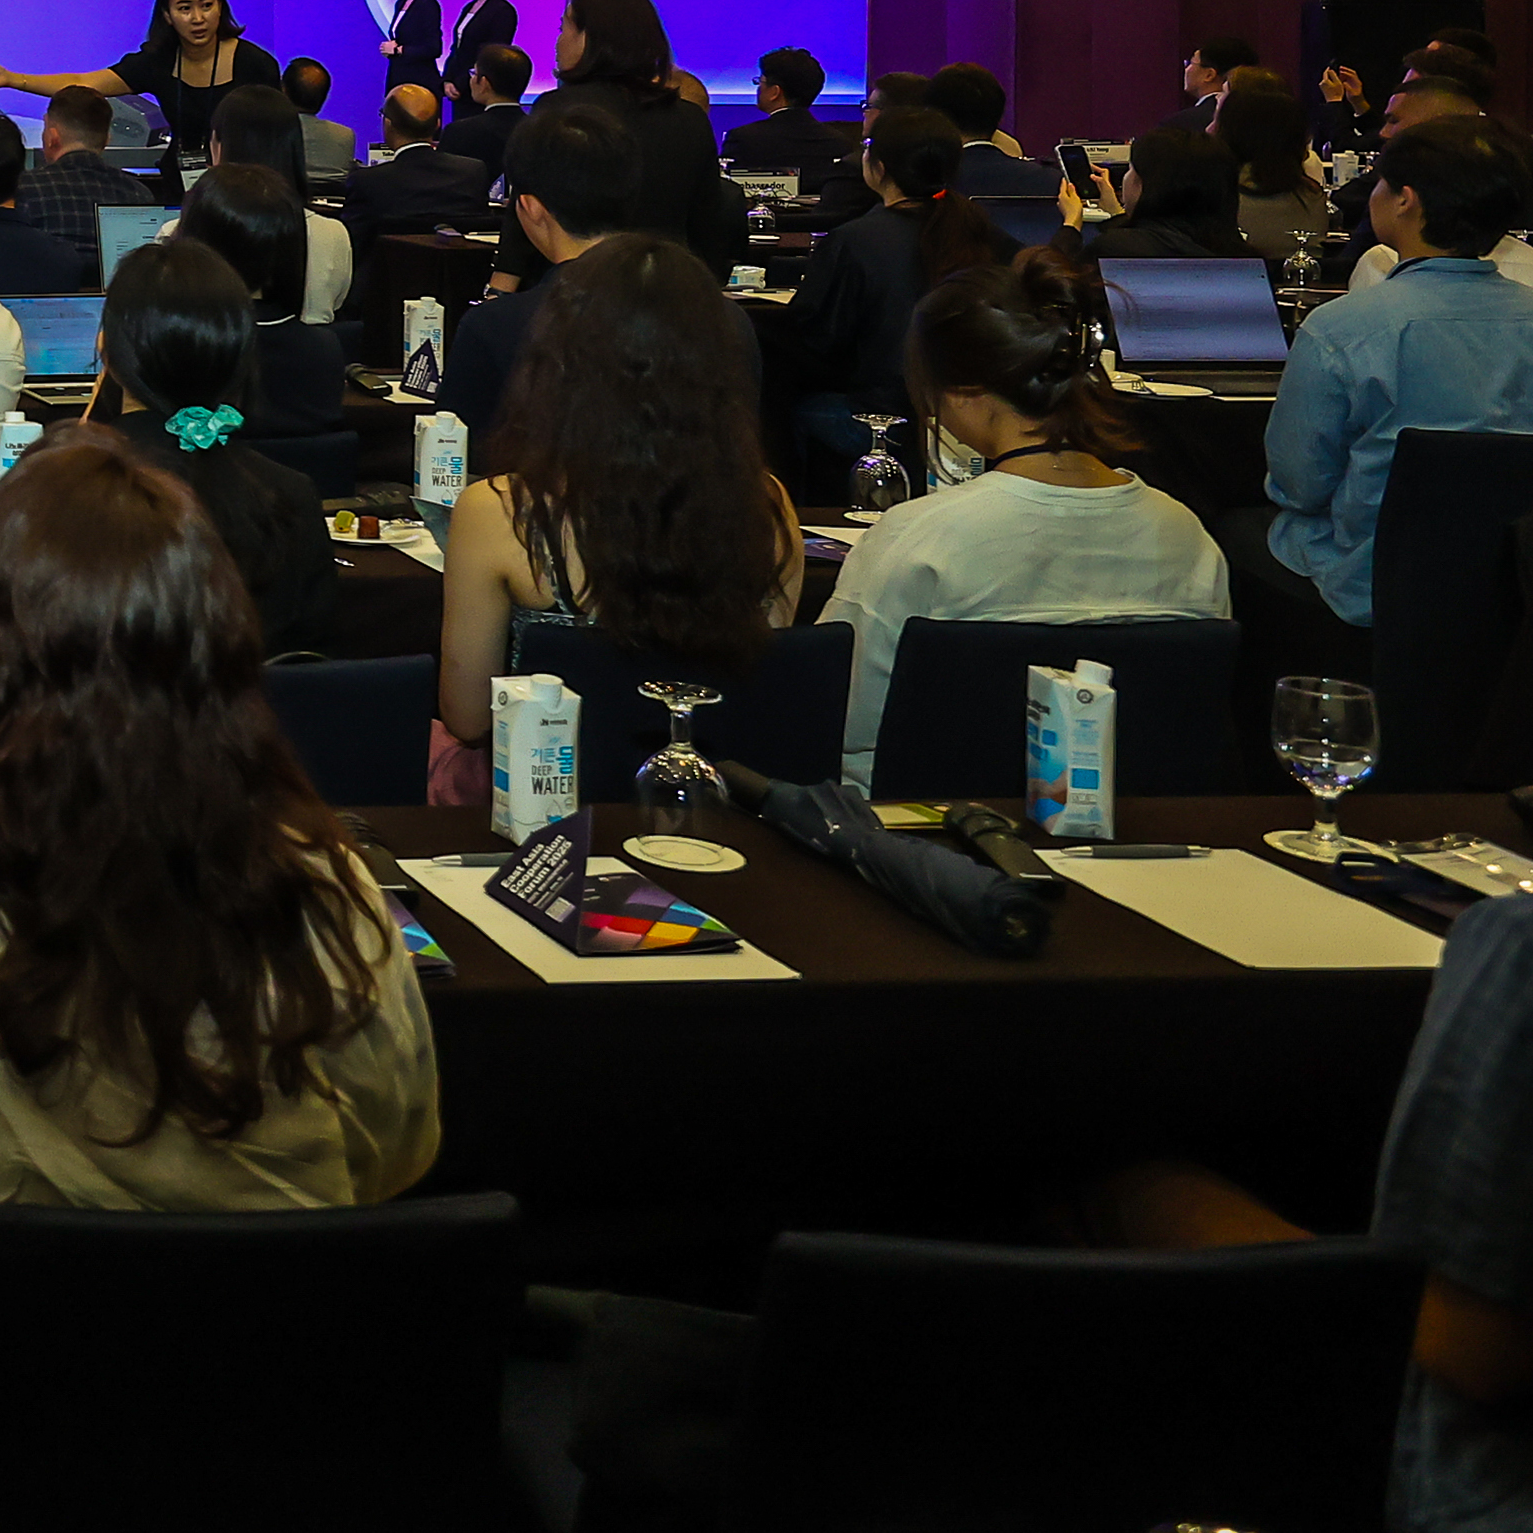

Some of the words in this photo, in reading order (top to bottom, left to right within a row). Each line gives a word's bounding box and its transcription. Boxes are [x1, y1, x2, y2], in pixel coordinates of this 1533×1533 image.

[432, 475, 462, 487] WATER
[532, 765, 552, 776] DEEP
[532, 776, 574, 794] WATER
[500, 861, 523, 889] East
[523, 843, 545, 869] Asia
[509, 834, 564, 894] Cooperation
[517, 864, 549, 900] Forum
